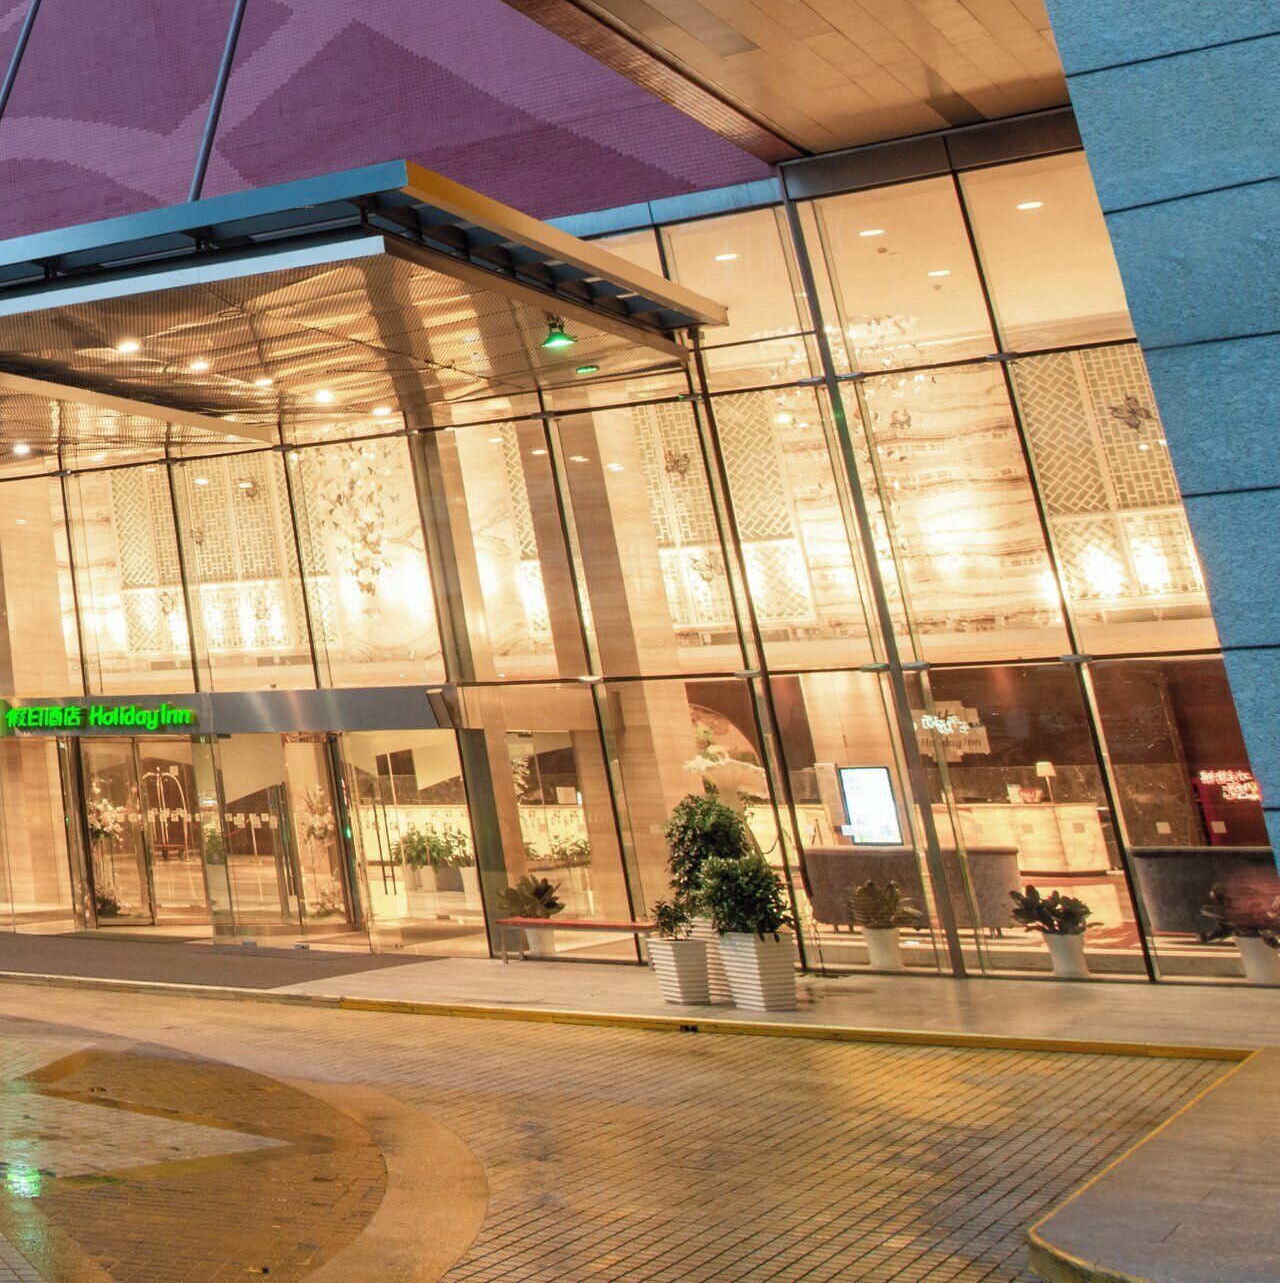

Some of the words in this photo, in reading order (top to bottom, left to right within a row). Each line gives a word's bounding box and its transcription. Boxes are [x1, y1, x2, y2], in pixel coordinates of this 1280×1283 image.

[5, 706, 81, 727] 假日酒店
[89, 705, 159, 731] Holiday
[161, 703, 192, 725] Inn
[921, 737, 961, 749] Hoday
[964, 737, 982, 747] Inn
